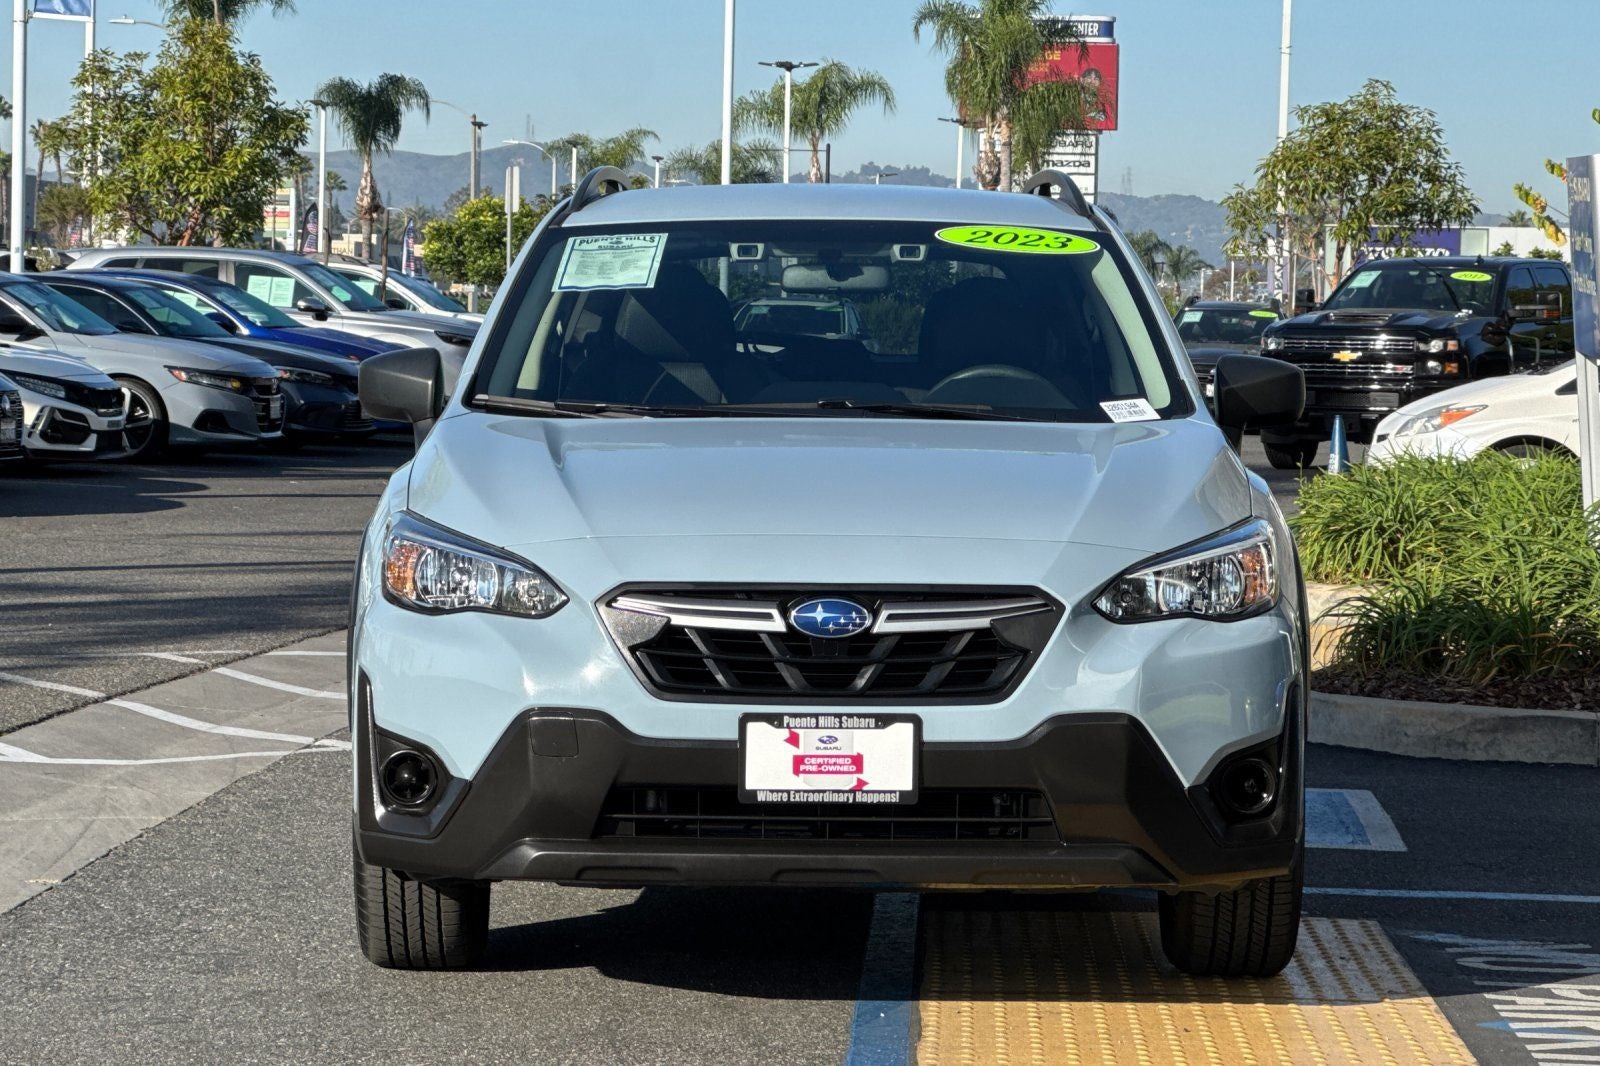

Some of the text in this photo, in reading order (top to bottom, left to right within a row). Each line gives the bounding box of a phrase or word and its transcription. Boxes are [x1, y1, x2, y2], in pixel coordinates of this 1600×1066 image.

[964, 230, 1073, 249] 2023
[784, 715, 876, 728] Puente Hills Subaru
[757, 791, 900, 803] Where Extraordinary Happens!
